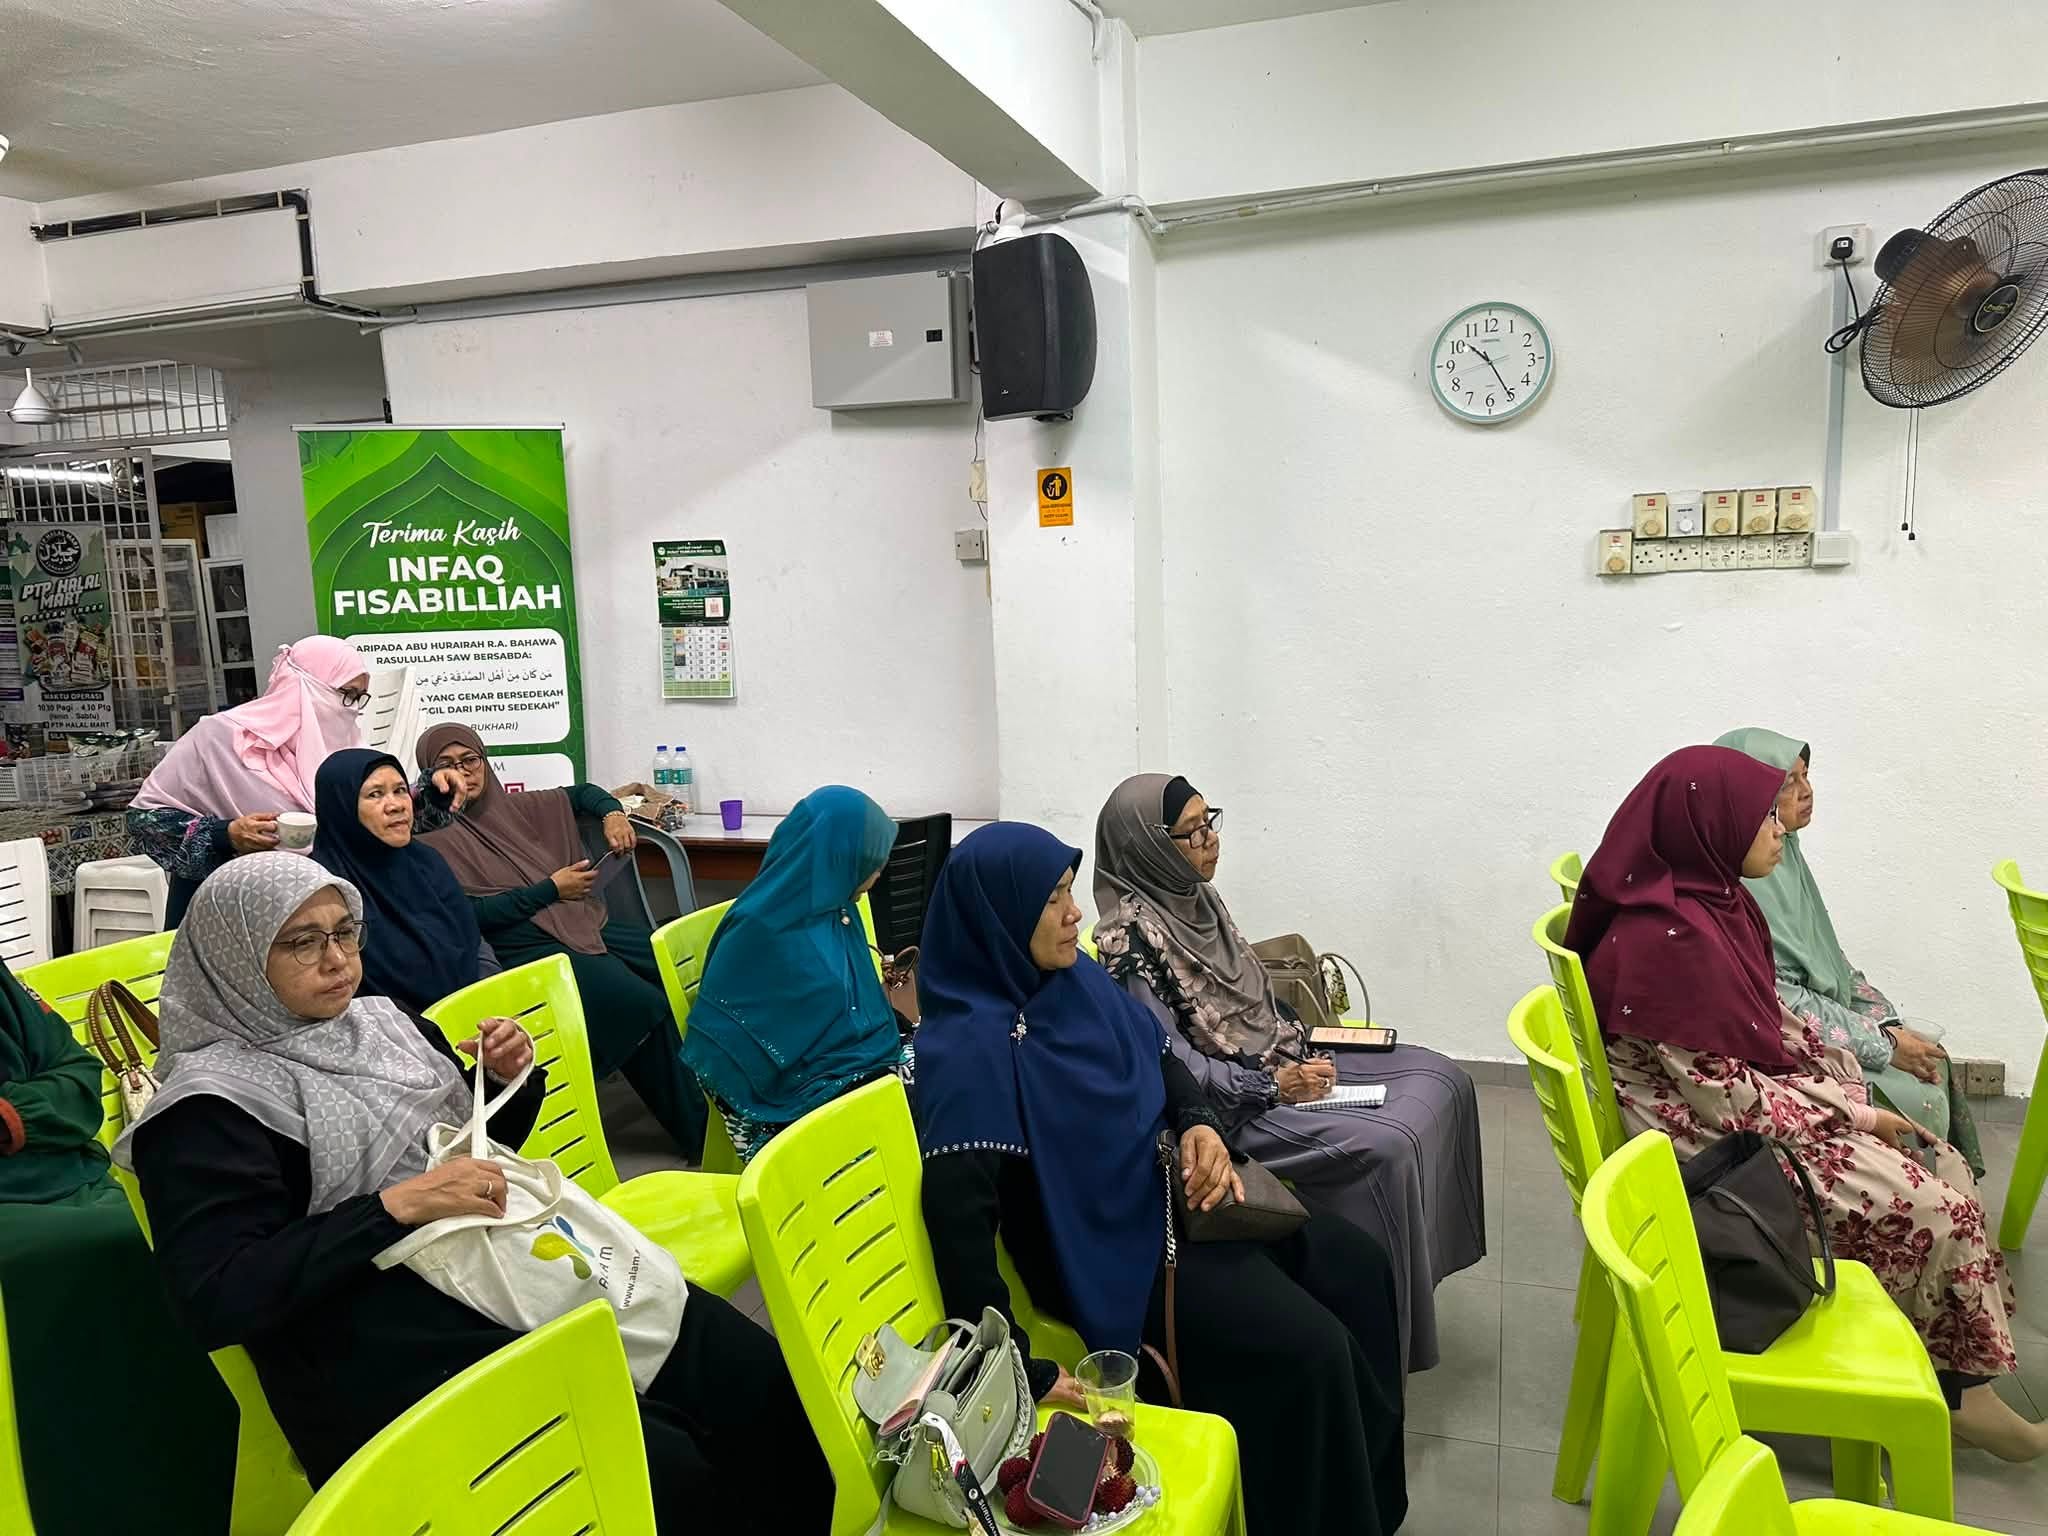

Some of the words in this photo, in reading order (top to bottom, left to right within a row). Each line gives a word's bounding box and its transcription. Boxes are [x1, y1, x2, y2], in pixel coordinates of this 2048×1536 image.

[1466, 323, 1477, 338] 11
[1485, 318, 1498, 333] 12
[1509, 319, 1514, 333] 1
[1450, 340, 1466, 354] 10
[1523, 333, 1532, 347] 2
[1446, 360, 1455, 374] 9
[1527, 352, 1536, 367] 3
[1452, 377, 1460, 392] 8
[1520, 372, 1531, 386] 4
[1465, 391, 1474, 405] 7
[1485, 392, 1495, 407] 6
[1506, 388, 1515, 402] 5
[363, 520, 447, 548] Terima
[452, 517, 521, 547] Kasih
[388, 555, 505, 585] INFAQ
[22, 582, 52, 599] PTP
[57, 574, 100, 592] HALAL
[40, 591, 82, 609] MART
[333, 584, 561, 616] FISABILLIAH
[356, 643, 403, 653] ARIPADA
[406, 642, 428, 651] ABU
[431, 640, 484, 650] HURAIRAH
[487, 640, 508, 648] R.A.
[510, 638, 557, 648] BAHAWA
[376, 655, 444, 664] RASULULLAH
[447, 653, 470, 662] SAW
[473, 652, 532, 661] BERSABDA:
[427, 693, 455, 703] YANG
[458, 692, 494, 701] GEMAR
[496, 689, 564, 699] BERSEDEKAH
[447, 704, 473, 713] DARI
[475, 702, 505, 712] PINTU
